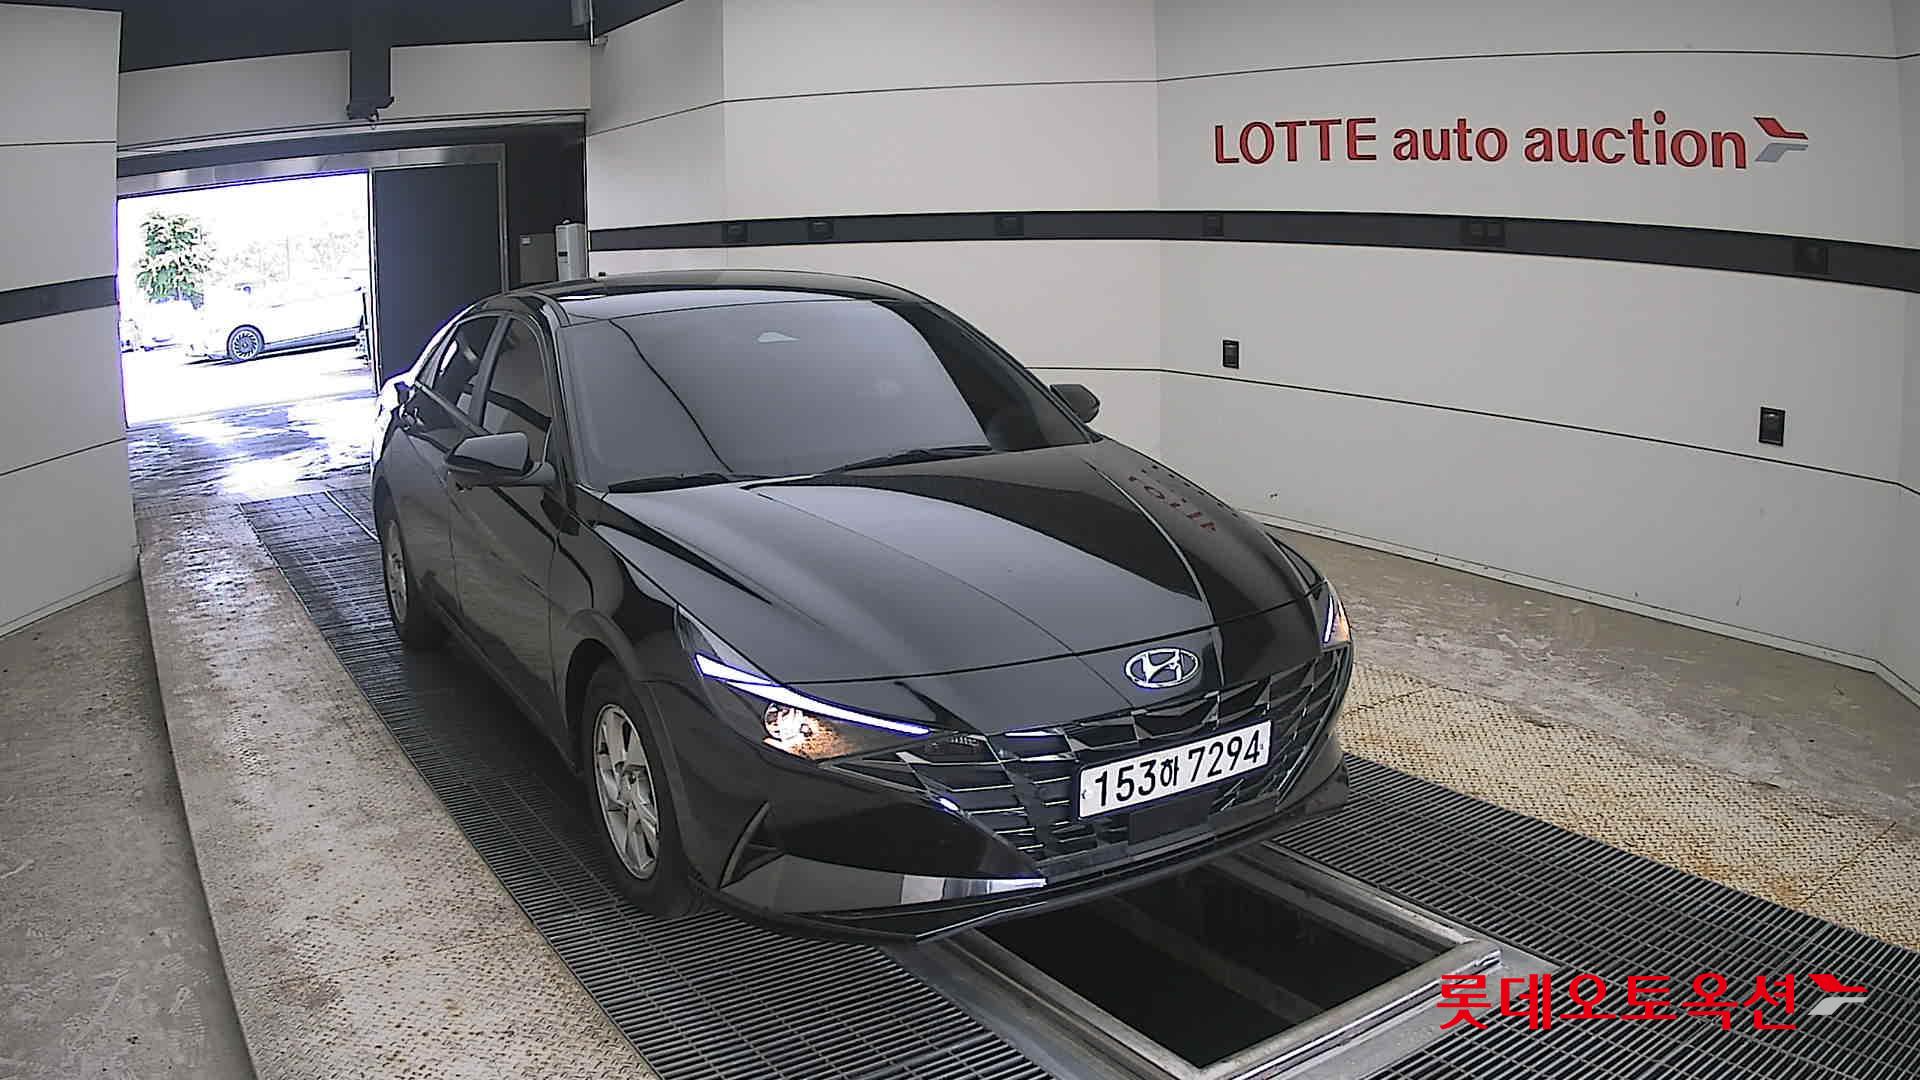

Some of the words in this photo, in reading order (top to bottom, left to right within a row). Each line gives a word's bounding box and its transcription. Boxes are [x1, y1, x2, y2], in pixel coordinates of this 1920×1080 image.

[1215, 118, 1377, 164] LOTTE
[1393, 118, 1508, 162] auto
[1524, 110, 1747, 169] auction
[1095, 755, 1179, 807] 153하
[1188, 729, 1260, 783] 7294
